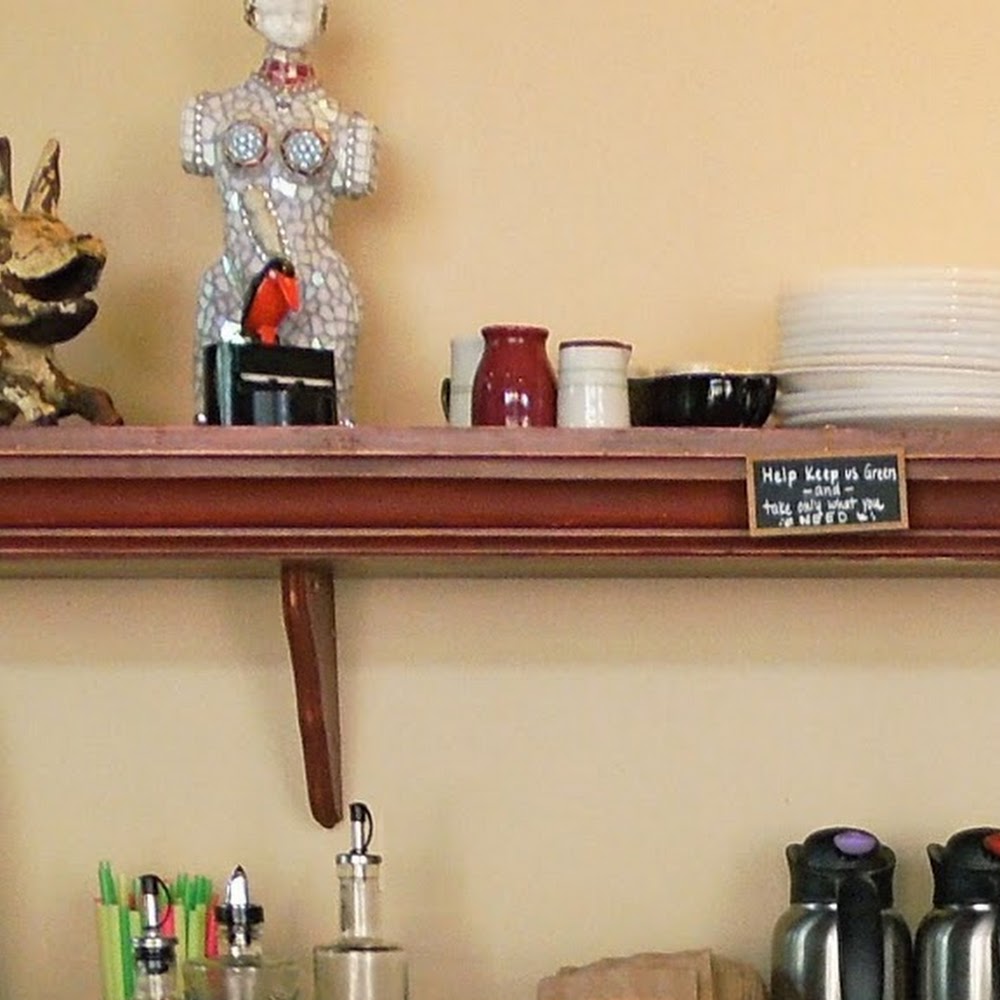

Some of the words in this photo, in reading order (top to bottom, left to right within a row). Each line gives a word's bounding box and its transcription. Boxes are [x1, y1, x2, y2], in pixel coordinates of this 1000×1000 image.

[763, 467, 797, 487] Help
[805, 465, 838, 484] Keep
[845, 467, 858, 480] us
[864, 463, 896, 481] Green
[763, 499, 792, 516] take
[797, 500, 822, 515] only
[827, 497, 858, 510] what
[799, 511, 847, 524] NEED
